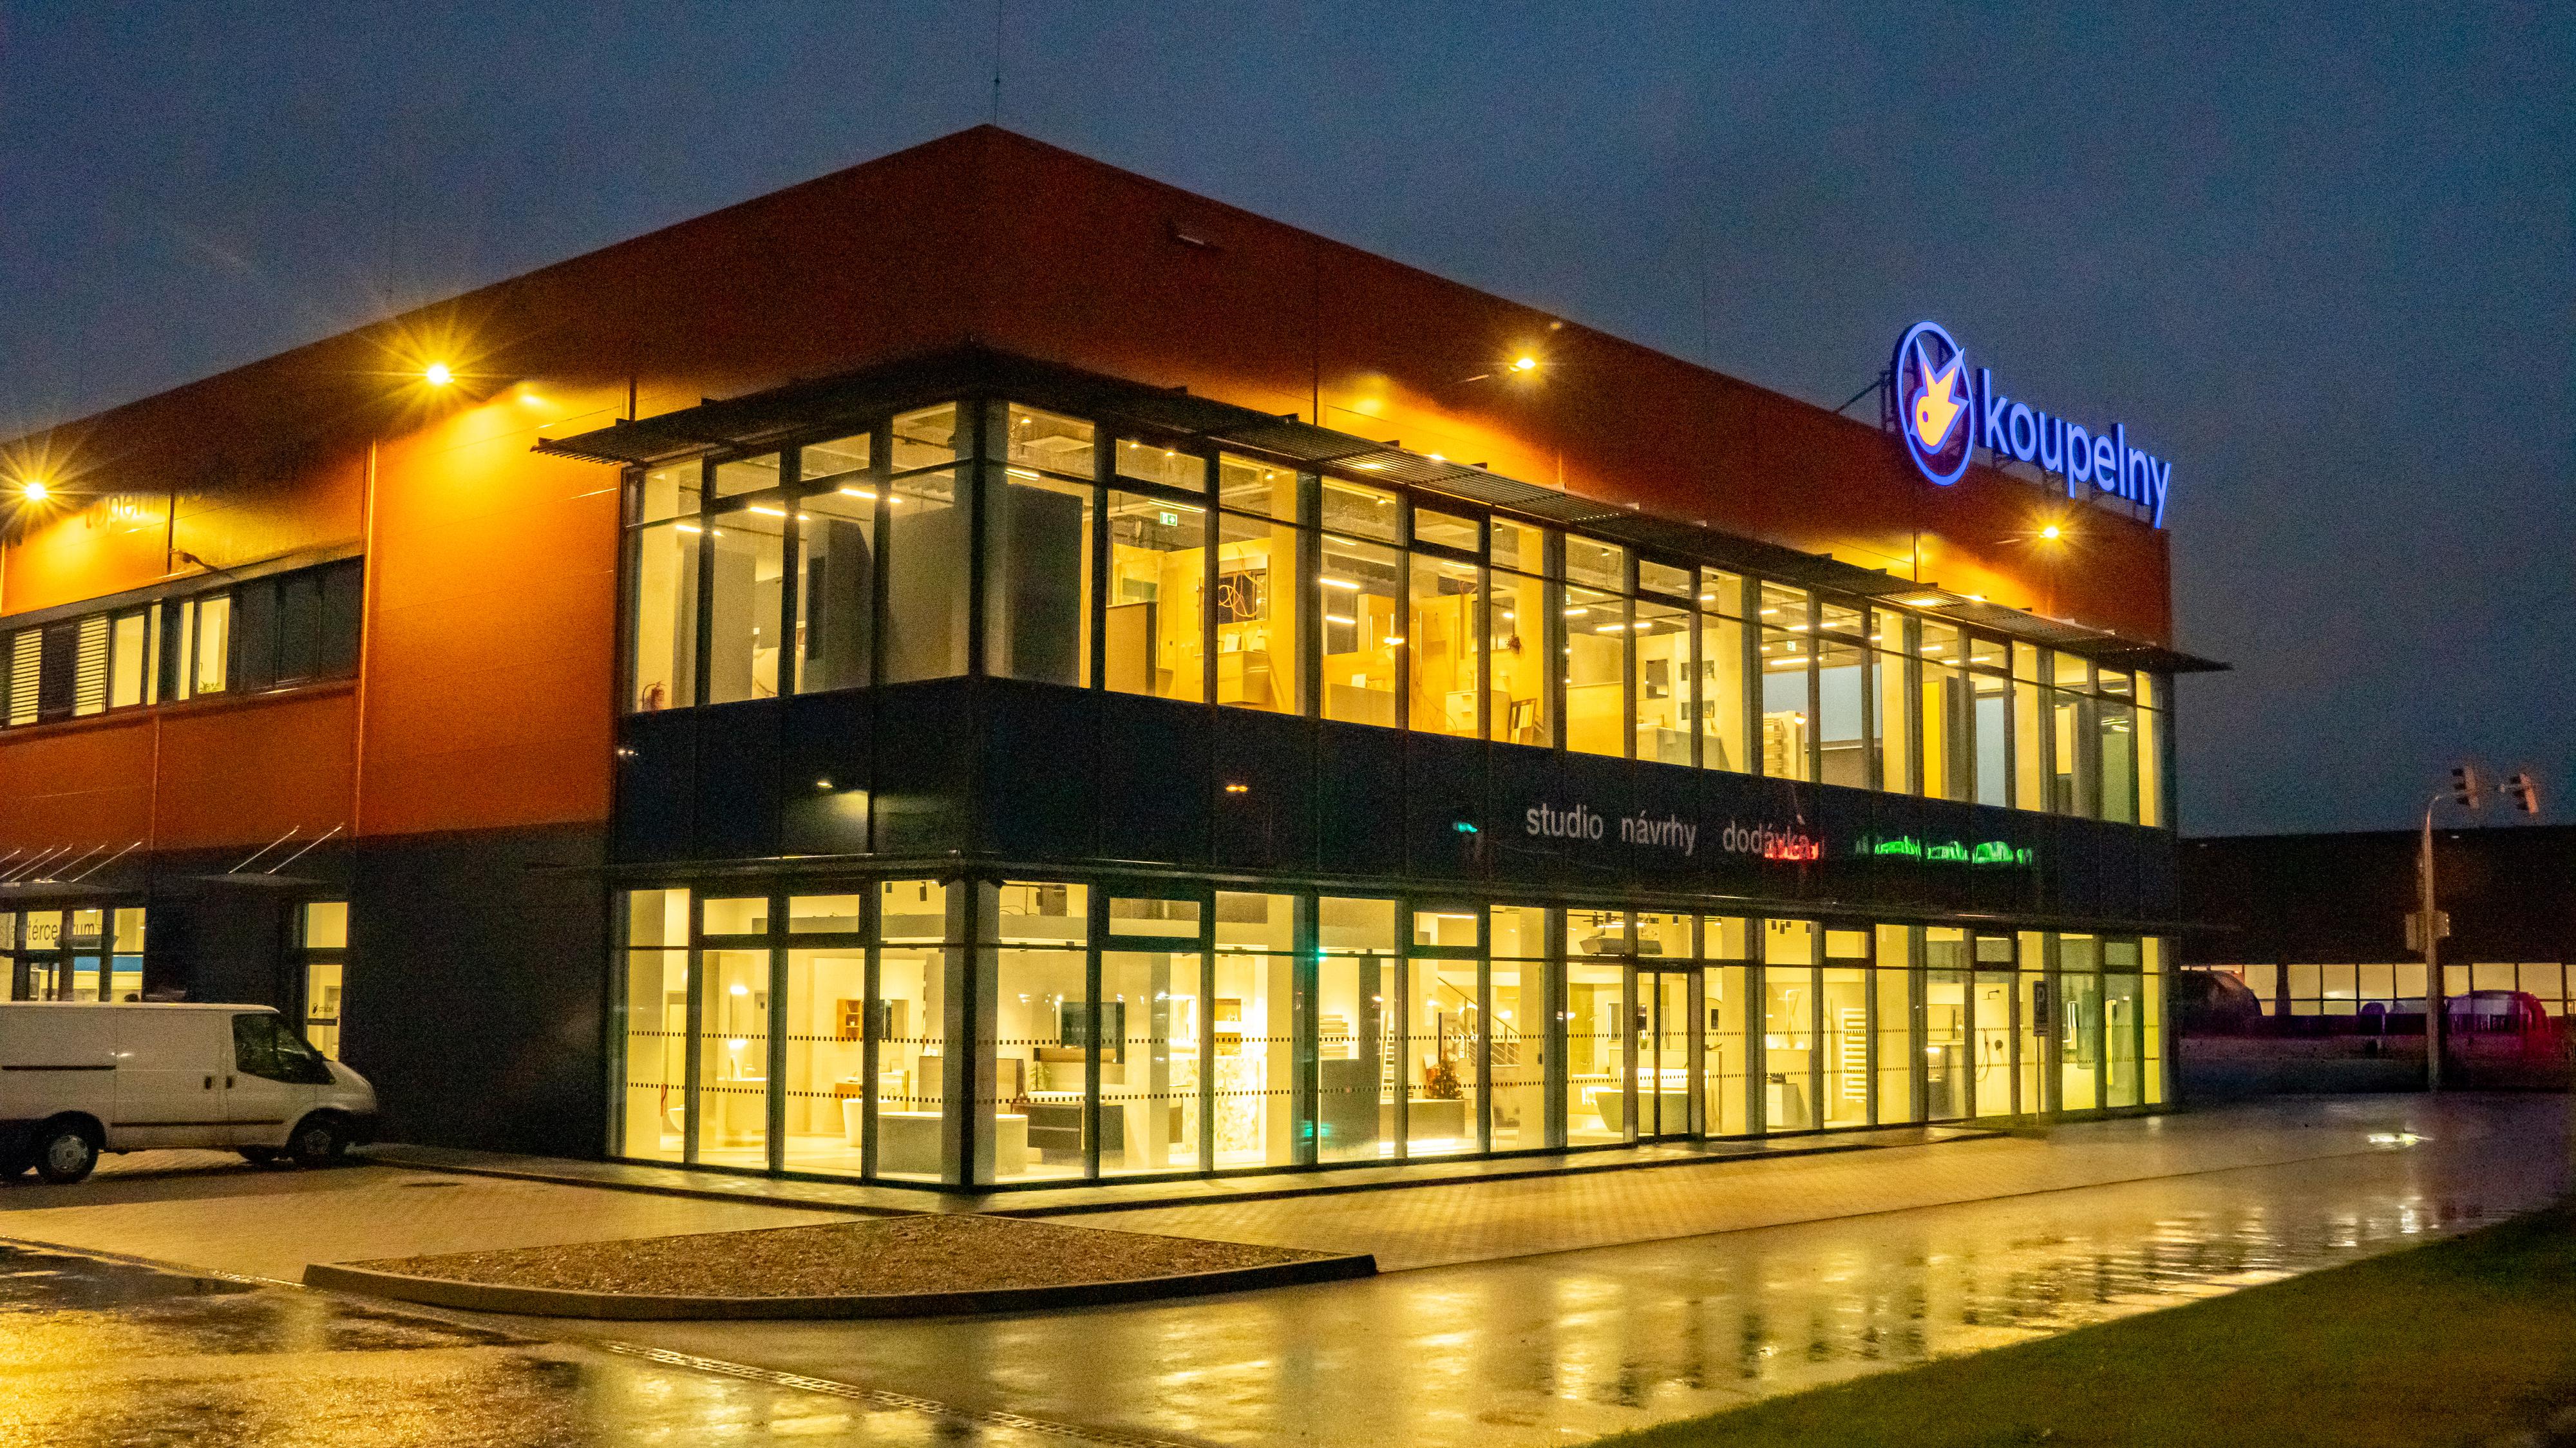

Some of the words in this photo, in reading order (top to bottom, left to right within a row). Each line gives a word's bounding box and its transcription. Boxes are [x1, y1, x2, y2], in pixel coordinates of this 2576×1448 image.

[1980, 368, 2172, 529] koupelny
[1526, 803, 1604, 840] studio
[1621, 809, 1697, 857] návrhy
